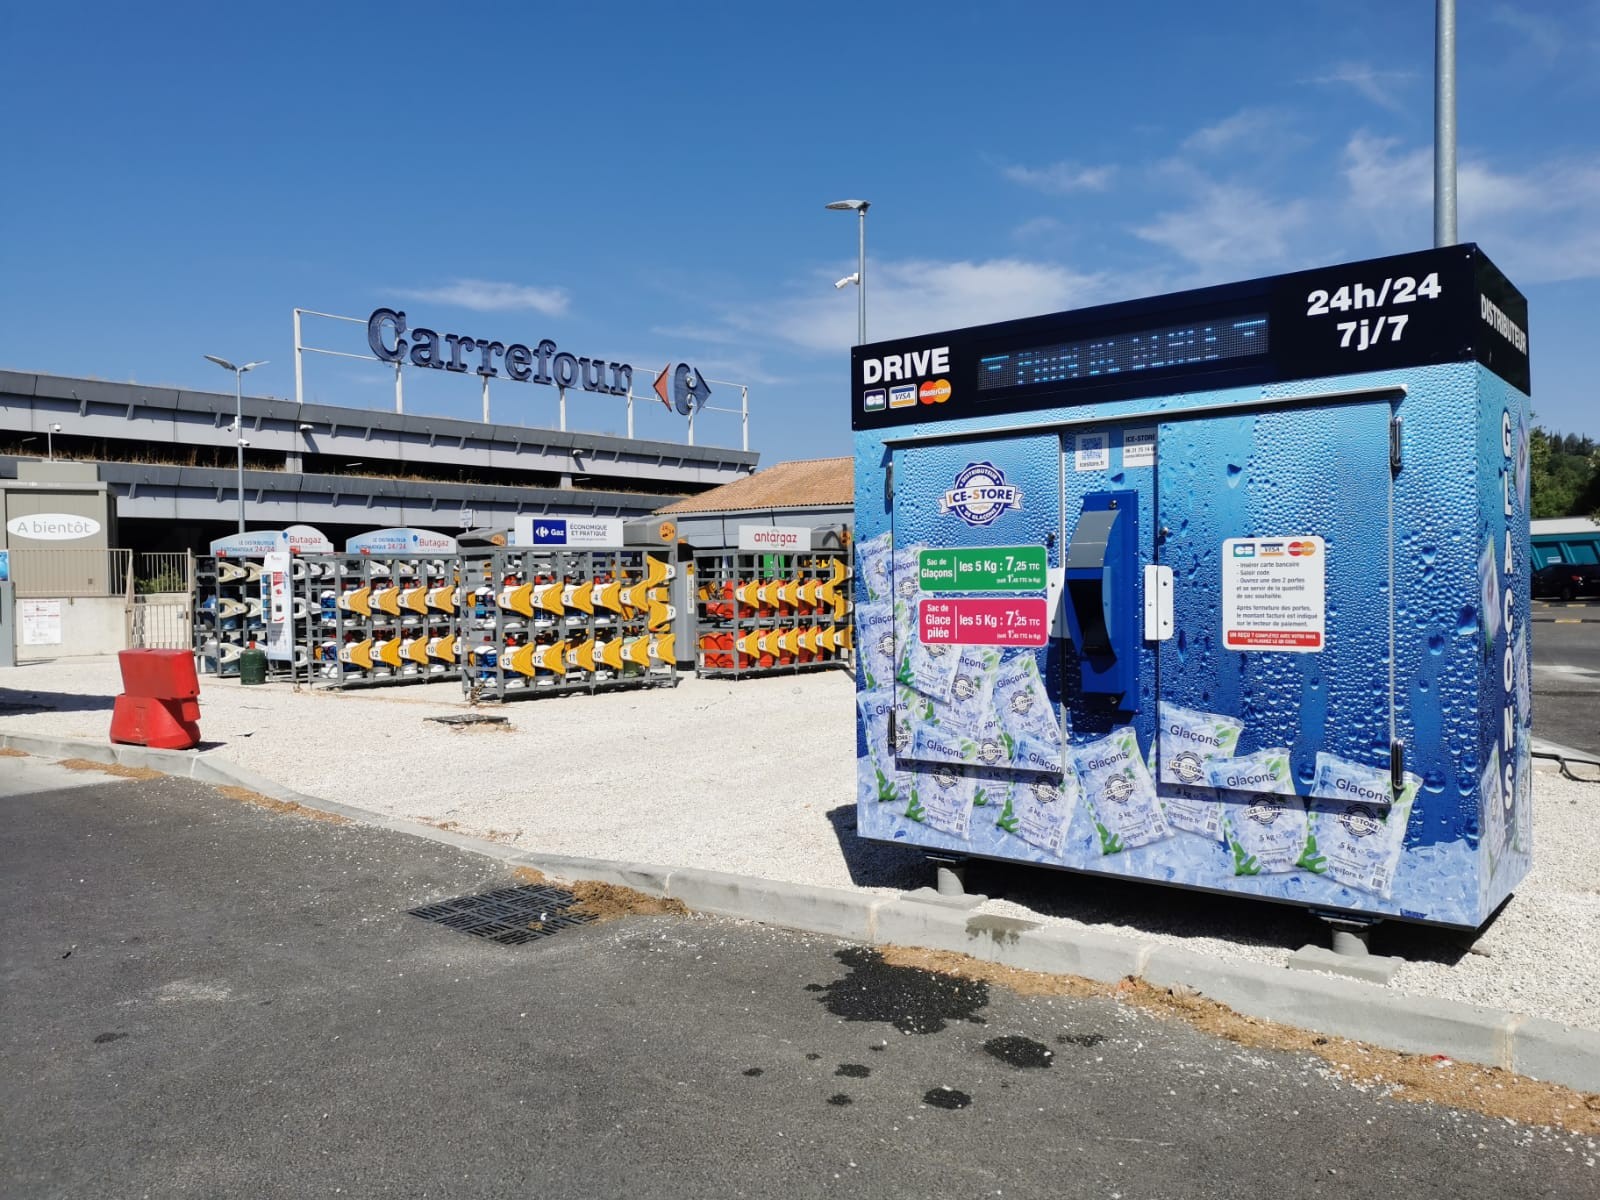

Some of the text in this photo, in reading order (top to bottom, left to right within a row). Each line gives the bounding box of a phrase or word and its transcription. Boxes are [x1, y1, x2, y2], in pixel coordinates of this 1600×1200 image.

[1307, 272, 1442, 316] 24h/24
[1480, 293, 1527, 356] DISTRIBUTEUR
[1337, 314, 1409, 351] 7j/7
[367, 307, 632, 396] Carrefour
[863, 346, 950, 384] DRIVE
[895, 392, 912, 400] VISA
[919, 387, 951, 398] MasterCard
[948, 489, 1013, 504] ICE-STORE
[17, 521, 91, 534] A bientôt
[550, 528, 564, 536] Gaz
[570, 522, 608, 530] ÉCONOMIQUE
[290, 535, 321, 545] Butagaz
[419, 538, 448, 547] Butagaz
[754, 531, 797, 546] antargaz
[668, 568, 672, 576] 6
[960, 562, 973, 572] les
[975, 561, 981, 571] 5
[984, 560, 997, 573] Kg
[921, 568, 953, 580] Glaçons
[534, 596, 539, 604] 2
[927, 604, 949, 612] Sac de
[1502, 410, 1514, 810] GLAÇONS
[926, 614, 950, 625] Glace
[960, 615, 973, 625] les
[976, 615, 982, 625] 5
[984, 614, 997, 628] Kg
[1029, 618, 1040, 626] TTC
[927, 626, 949, 640] pilée
[371, 650, 379, 658] 12
[594, 651, 601, 659] 10
[650, 646, 655, 654] 8
[533, 656, 542, 664] 12
[569, 653, 575, 661] 11
[997, 671, 1030, 688] Glaçons
[1170, 724, 1220, 747] Glaçons
[927, 740, 964, 759] Glaçons
[1088, 752, 1129, 770] Glaçons
[1226, 772, 1276, 786] Glaçons
[1336, 778, 1391, 804] Glaçons
[1346, 843, 1357, 857] kg
